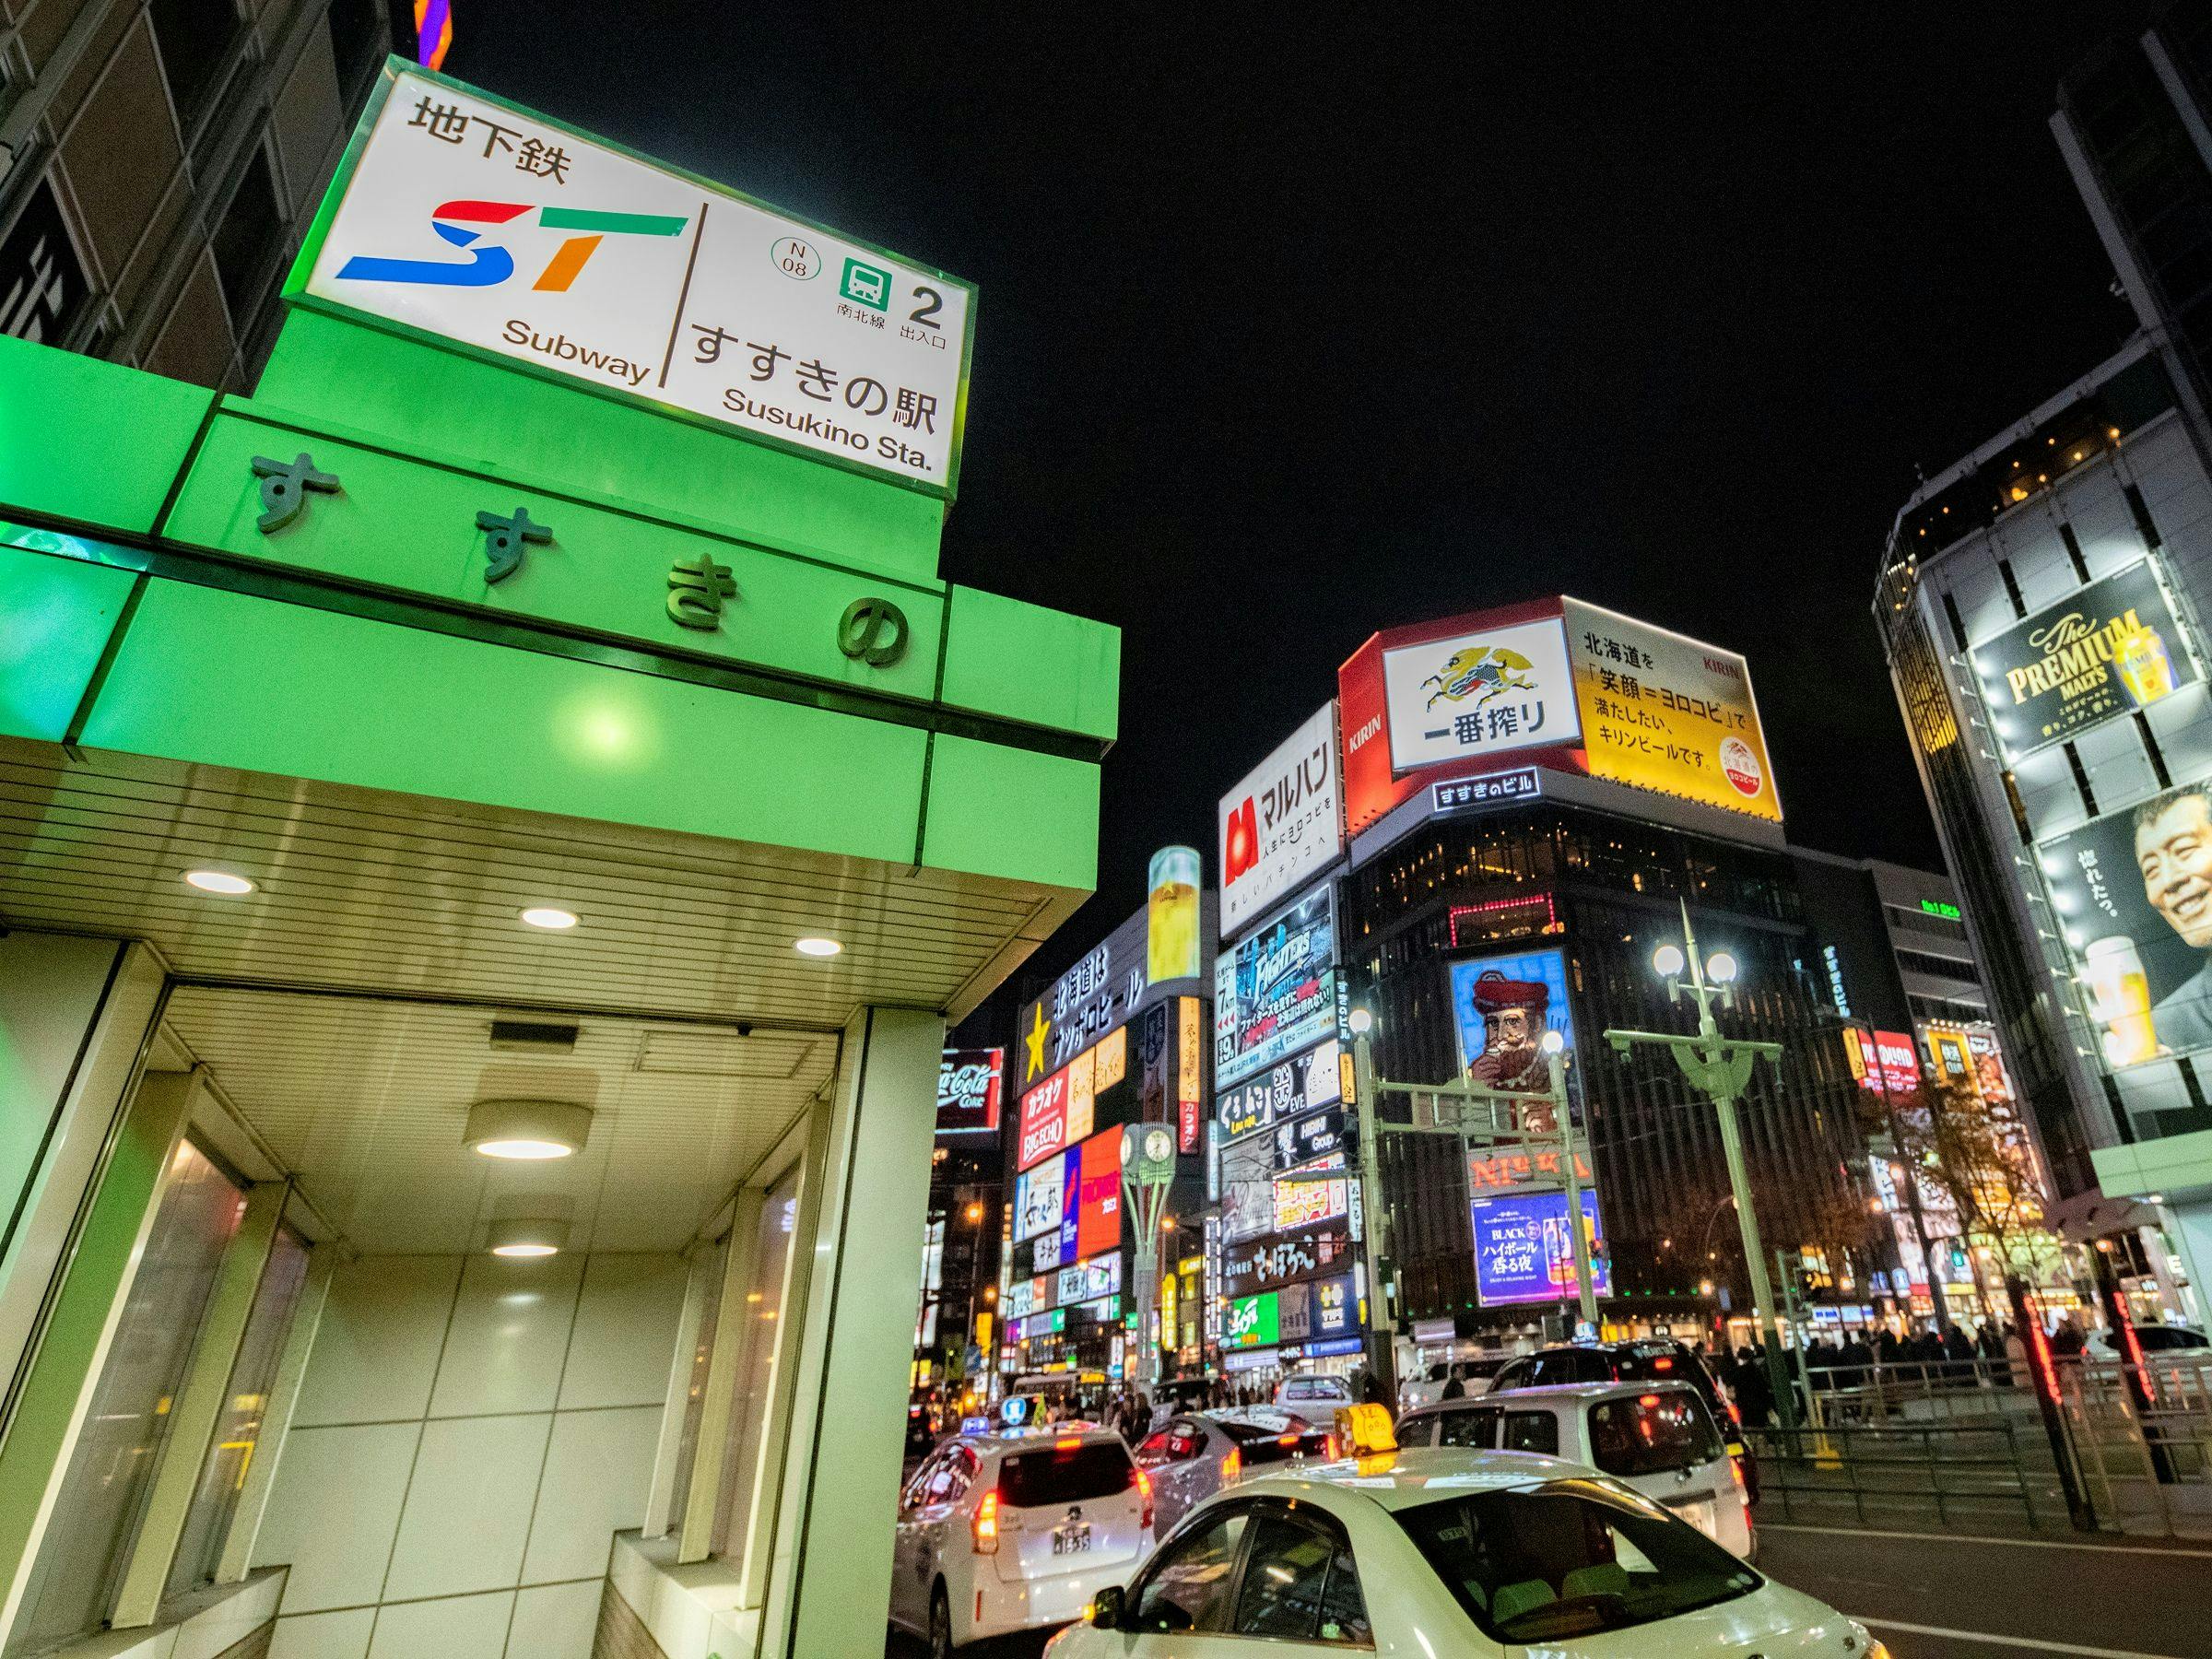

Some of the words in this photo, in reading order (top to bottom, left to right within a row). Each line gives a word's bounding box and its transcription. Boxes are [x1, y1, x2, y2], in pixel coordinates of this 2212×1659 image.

[407, 96, 572, 185] 地下鉄
[782, 258, 807, 278] 08
[790, 241, 806, 256] N
[836, 302, 887, 332] 南北線
[909, 287, 946, 331] 2
[502, 318, 651, 387] Subway
[900, 324, 948, 351] 出入口
[690, 323, 937, 437] すすきの駅
[722, 387, 870, 452] Susukino
[877, 435, 934, 473] Sta.
[251, 452, 910, 667] すすきの
[1583, 631, 1654, 670] 北海道を
[2029, 613, 2097, 654] The
[1702, 655, 1741, 679] KIRIN
[2006, 608, 2142, 705] PREMIUM
[1348, 713, 1382, 755] KIRIN
[1424, 700, 1547, 745] 一番搾り
[1261, 740, 1327, 831] マルハン
[1440, 773, 1534, 805] すすきのビル
[1263, 796, 1331, 861] 人生にヨロコビを
[1253, 928, 1311, 1010] FIGHTERS
[1051, 969, 1143, 1067] サッポロビール
[1027, 1077, 1064, 1119] カラオケ
[1289, 1093, 1306, 1113] EVE
[1023, 1131, 1040, 1161] BIG
[1040, 1116, 1064, 1146] ECHO
[1183, 1101, 1195, 1147] カラオケ
[1482, 1241, 1538, 1256] ハイボール
[1491, 1228, 1526, 1241] BLACK
[1492, 1254, 1534, 1275] 香る夜
